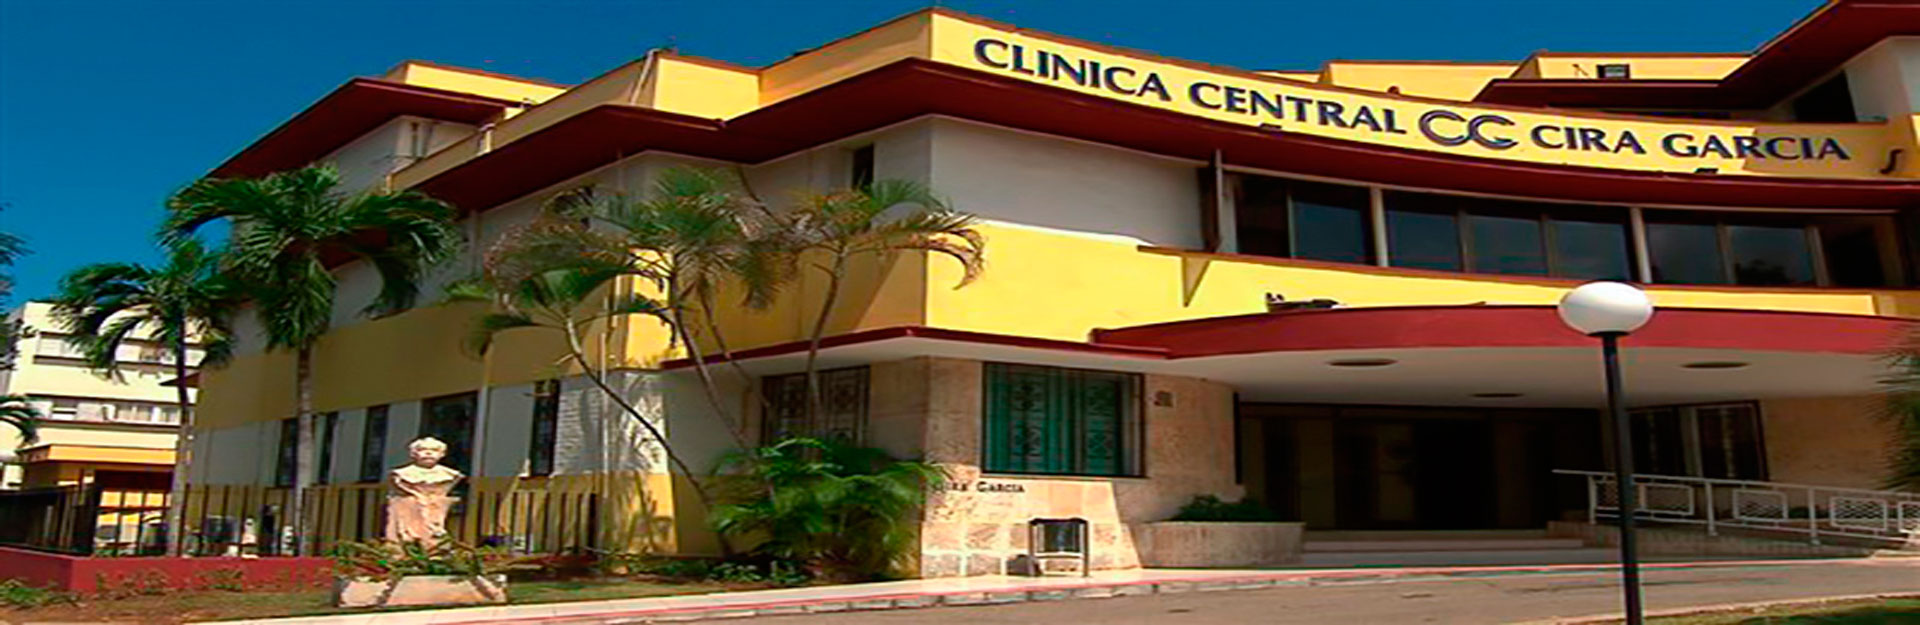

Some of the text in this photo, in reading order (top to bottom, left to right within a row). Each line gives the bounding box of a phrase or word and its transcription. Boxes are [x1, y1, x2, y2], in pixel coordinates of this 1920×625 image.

[973, 38, 1172, 101] CLINICA
[1188, 81, 1407, 135] CENTRAL
[1530, 124, 1647, 155] CIRA
[1661, 132, 1851, 161] GARCIA
